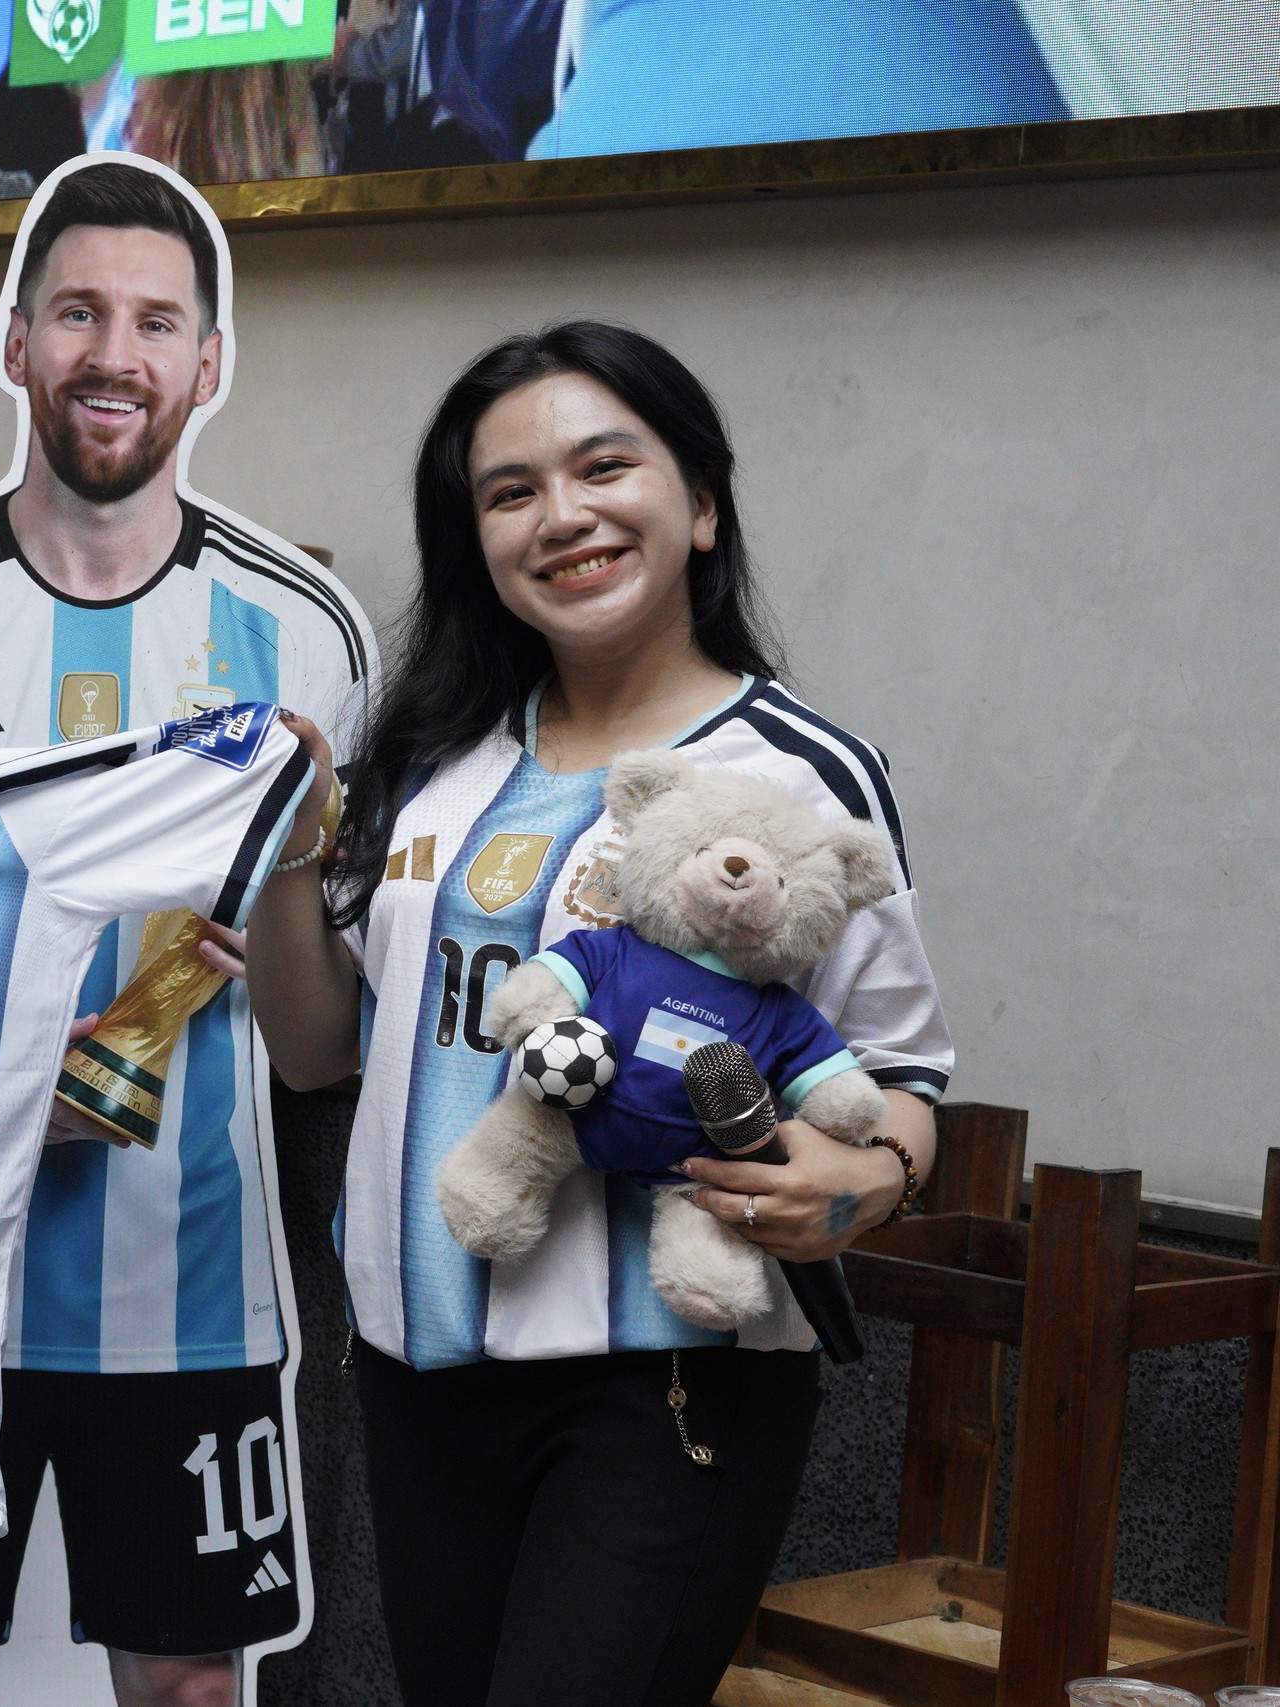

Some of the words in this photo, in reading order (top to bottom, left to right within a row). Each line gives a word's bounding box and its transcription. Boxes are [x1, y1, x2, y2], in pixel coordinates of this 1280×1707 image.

[155, 0, 304, 42] BEN
[230, 713, 249, 737] FIFA
[482, 877, 514, 891] FIFA
[483, 893, 503, 902] 2022
[435, 936, 522, 1055] 10
[661, 996, 725, 1028] AGENTINA
[183, 1416, 287, 1554] 10
